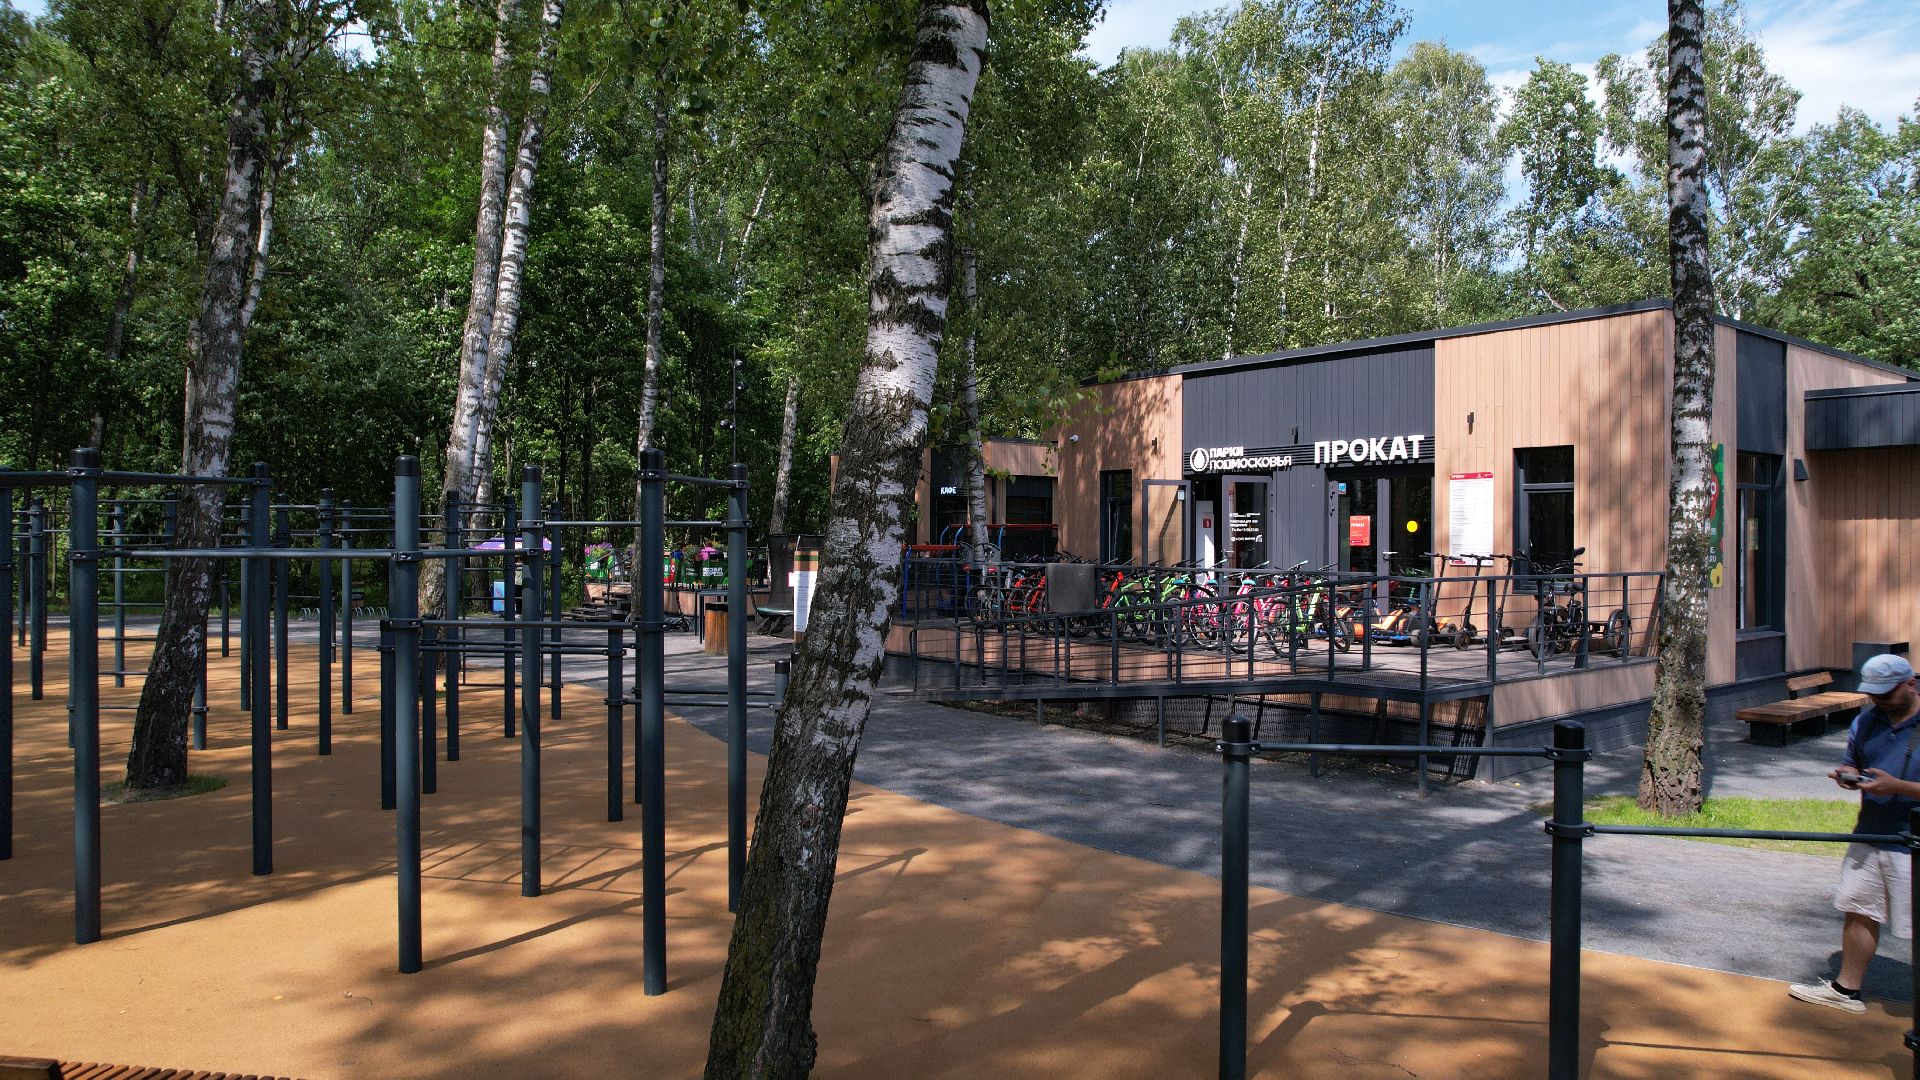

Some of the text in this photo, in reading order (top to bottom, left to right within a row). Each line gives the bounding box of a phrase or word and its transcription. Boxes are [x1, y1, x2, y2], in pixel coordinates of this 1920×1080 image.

[1210, 446, 1244, 458] ПАРКИ
[1314, 435, 1425, 463] ПРОКАТ
[1210, 456, 1292, 470] ПОДМОСКОВЬЯ
[941, 486, 956, 495] КАФЕ
